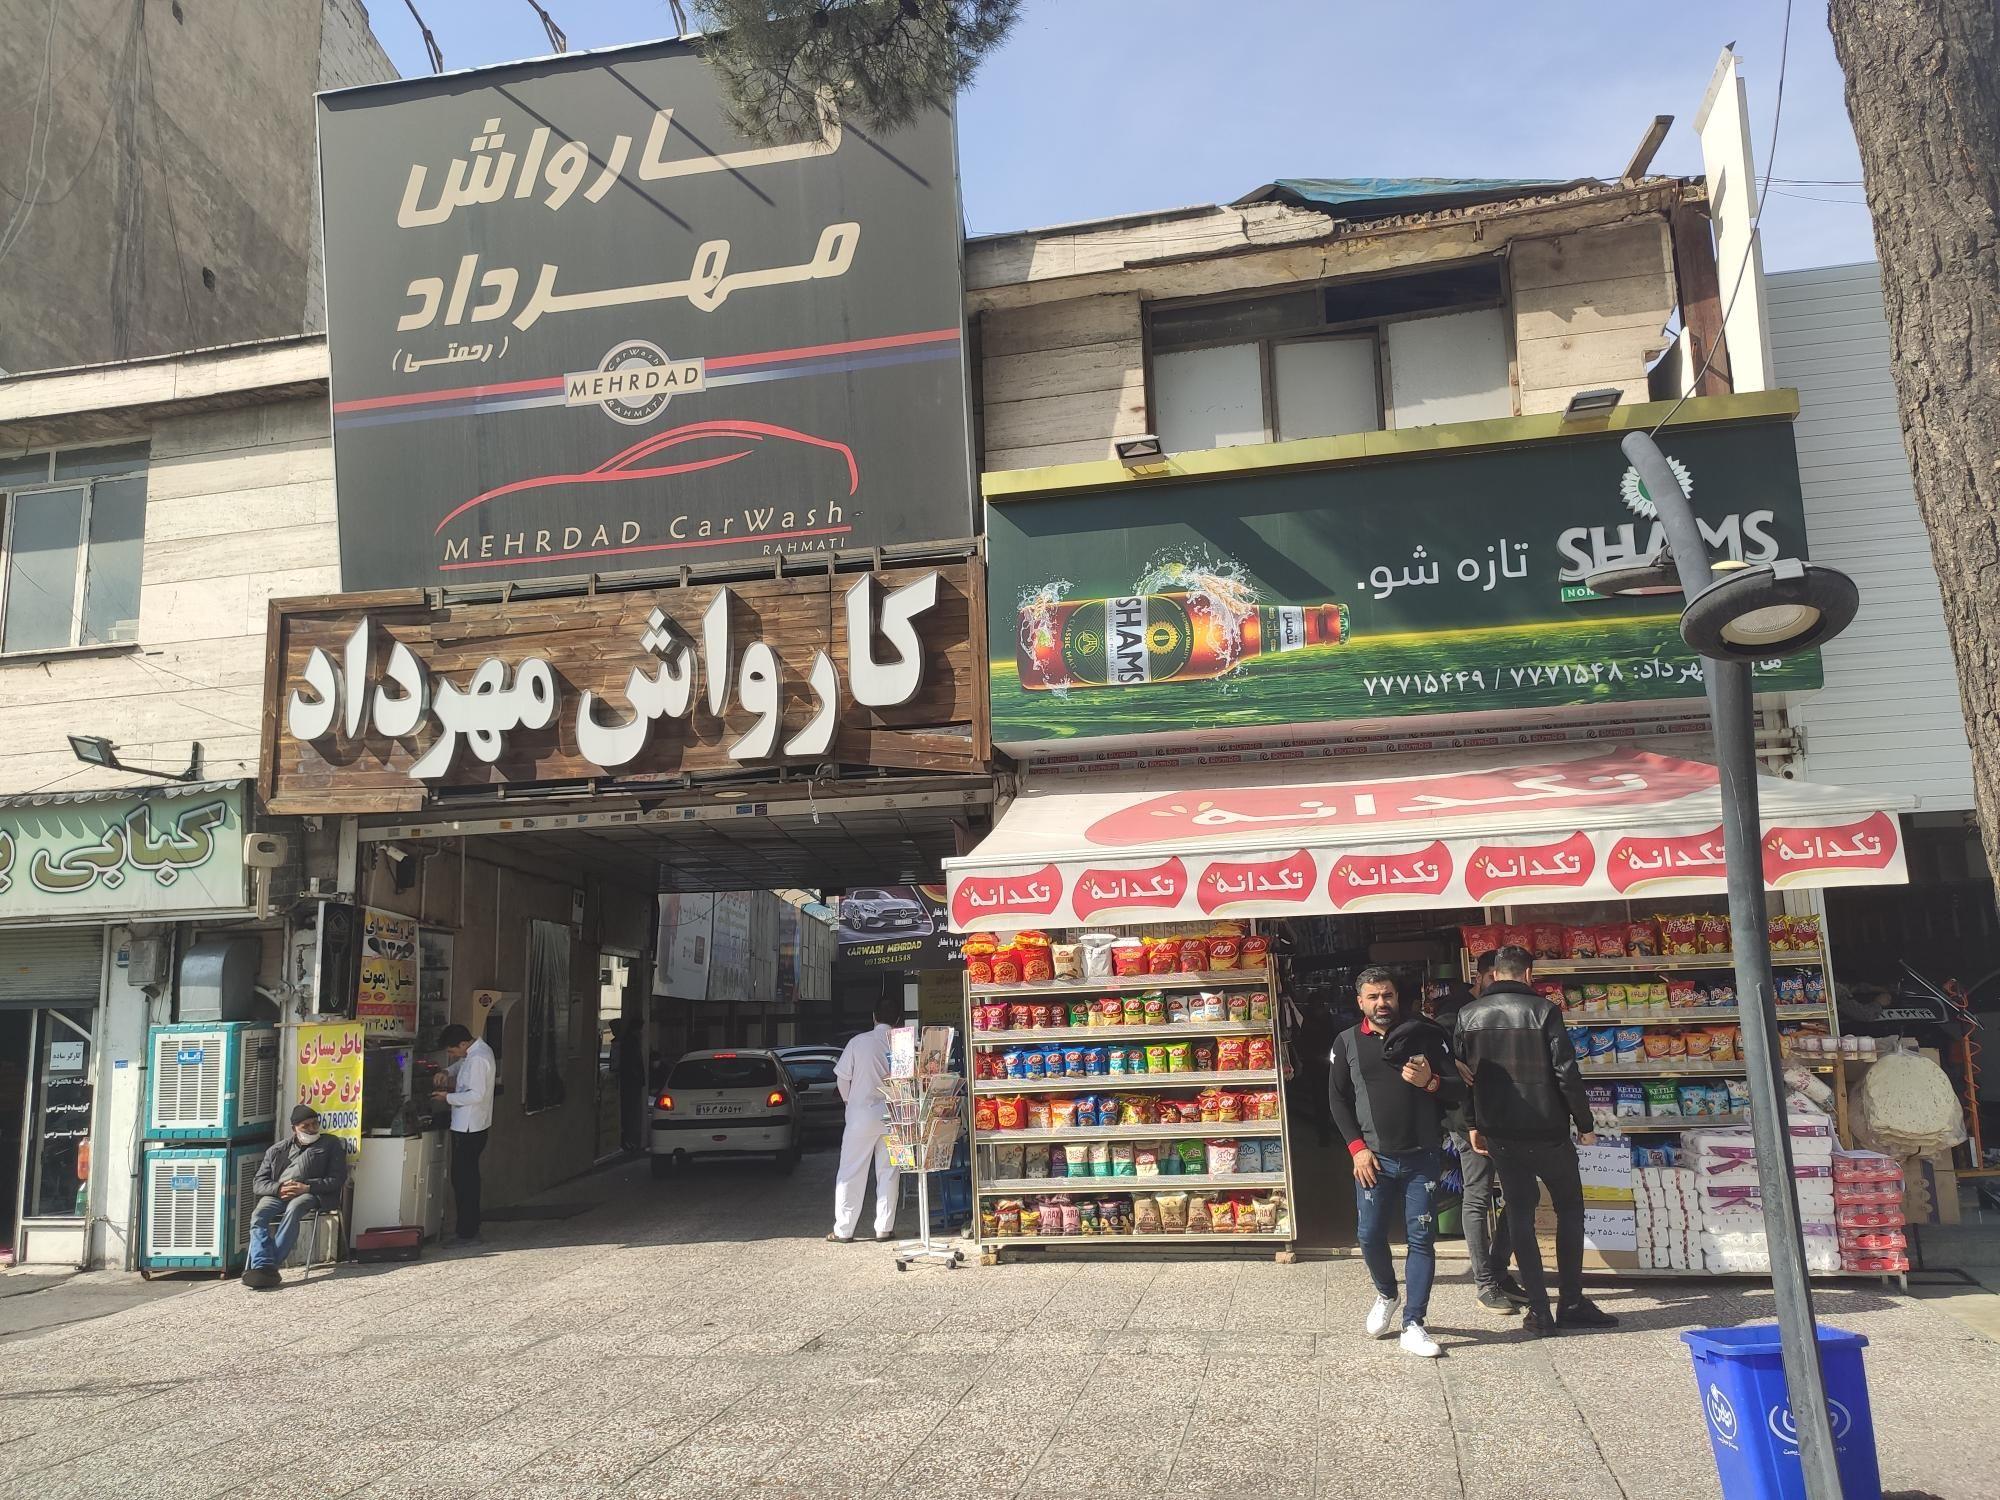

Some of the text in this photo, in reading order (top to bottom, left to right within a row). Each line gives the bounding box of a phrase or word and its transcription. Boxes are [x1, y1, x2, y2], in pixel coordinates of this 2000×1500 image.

[396, 222, 861, 331] مهرداد
[608, 349, 660, 371] CarWash
[569, 366, 699, 398] MEHRDAD
[608, 395, 664, 418] RAHMATI
[443, 500, 843, 562] MEHRDAD CarWash
[763, 536, 847, 556] RAHMATI
[1456, 538, 1529, 593] تازه
[1114, 597, 1146, 684] SHAMS
[1362, 669, 1486, 697] ۷۷۷۱۵۴۴۹
[1509, 660, 1624, 687] ۷۷۷۱۵۴۸
[287, 614, 556, 779] مهرداد
[1192, 772, 1648, 825] تکدانه
[30, 800, 227, 893] کبابی
[1779, 832, 1883, 861] تکدانه
[1347, 860, 1440, 887] تکدانه
[1484, 852, 1582, 879] تکدانه
[970, 882, 1051, 907] تکدانه
[1090, 875, 1176, 900] تکدانه
[1216, 871, 1304, 893] تکدانه
[887, 940, 923, 954] MEHRDAD
[299, 1072, 361, 1105] برق خودرو
[1585, 1088, 1612, 1098] KETTLE
[1617, 1086, 1643, 1094] KETTLE
[1649, 1086, 1676, 1095] KETTLE
[1592, 1164, 1614, 1173] ۳۵۵۰۰
